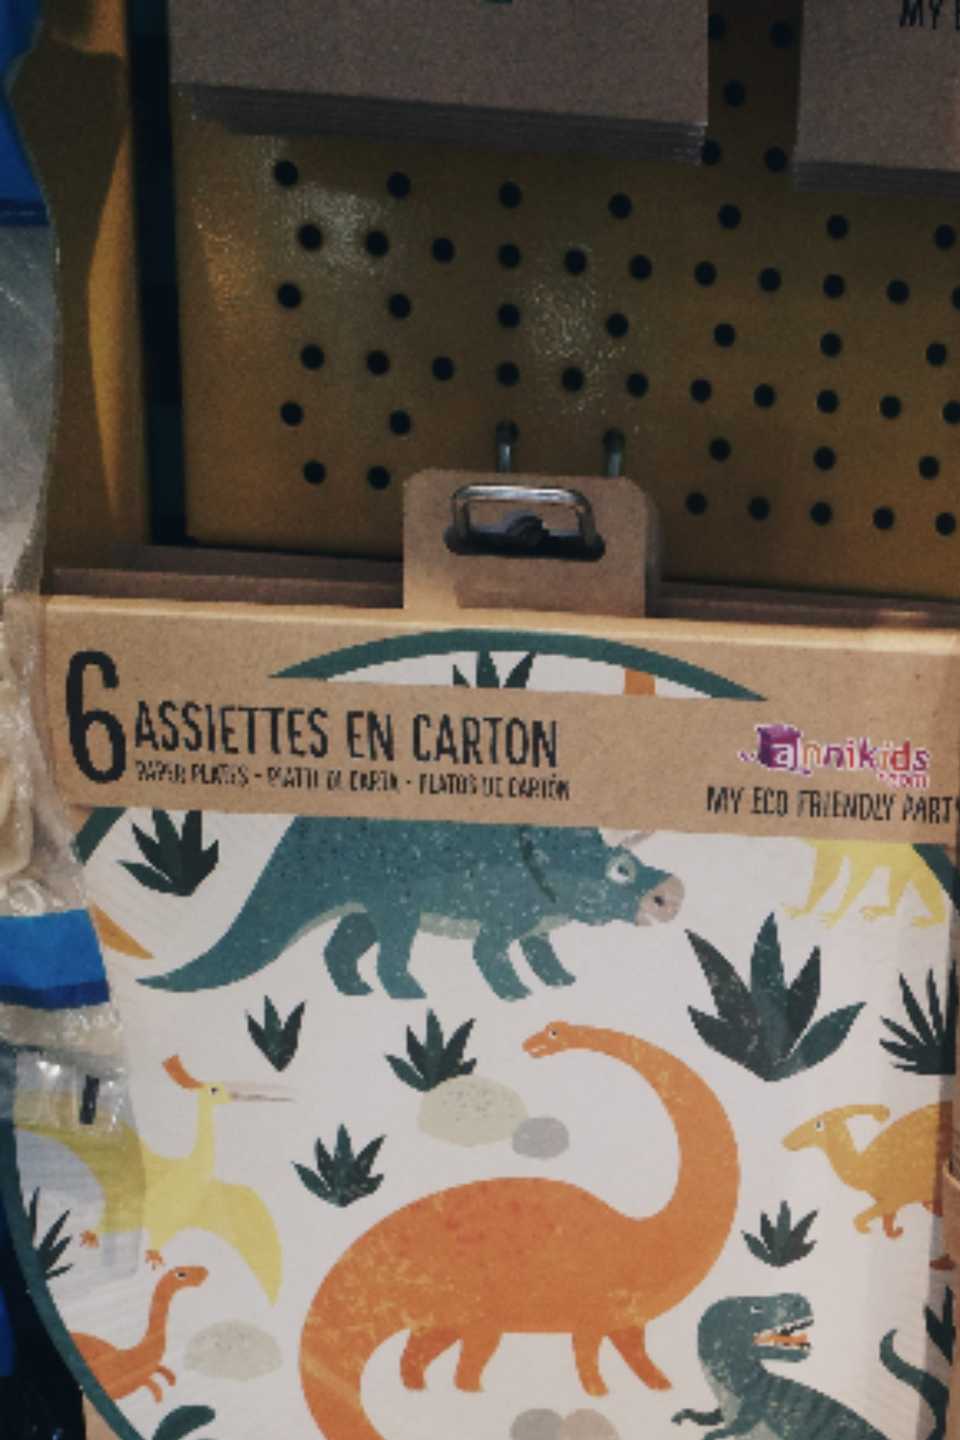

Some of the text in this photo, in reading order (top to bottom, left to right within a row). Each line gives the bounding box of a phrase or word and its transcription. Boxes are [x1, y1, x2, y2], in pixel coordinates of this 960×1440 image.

[899, 0, 940, 30] MY
[66, 651, 557, 783] 6 ASSIETTES EN CARTON
[706, 786, 745, 815] MY
[753, 786, 789, 817] ECO
[797, 790, 898, 822] FRIENDLY
